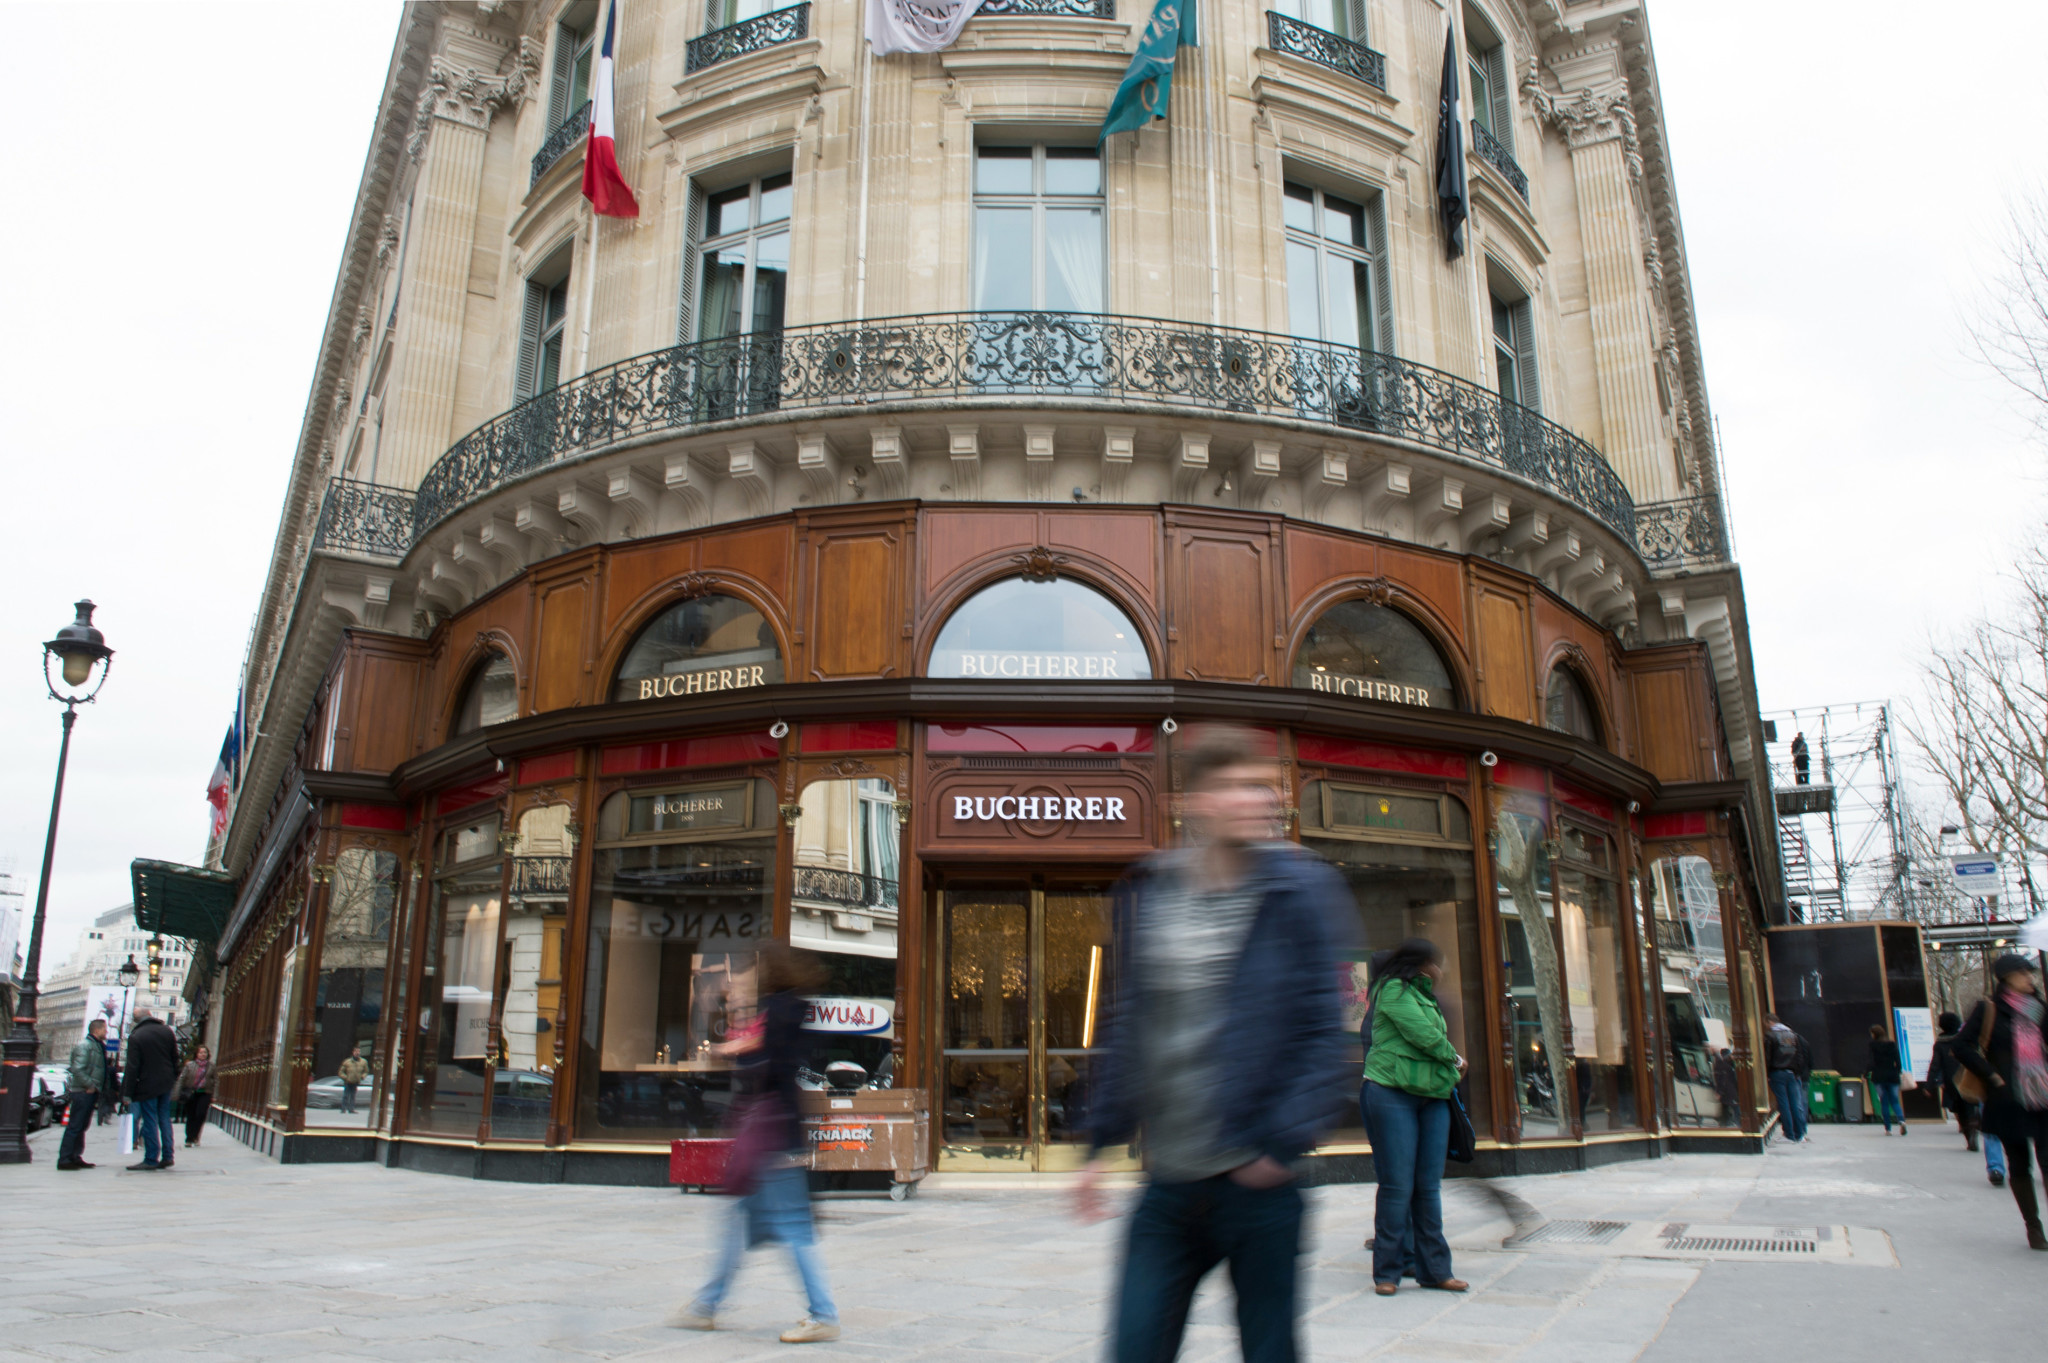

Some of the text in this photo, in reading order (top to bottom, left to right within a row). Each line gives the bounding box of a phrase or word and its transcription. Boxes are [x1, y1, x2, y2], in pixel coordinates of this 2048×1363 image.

[960, 654, 1119, 678] BUCHERER
[639, 666, 766, 700] BUCHERER
[1310, 673, 1430, 708] BUCHERER
[653, 798, 724, 815] BUCHERER
[953, 796, 1127, 821] BUCHERER
[807, 1129, 874, 1141] KNAACK
